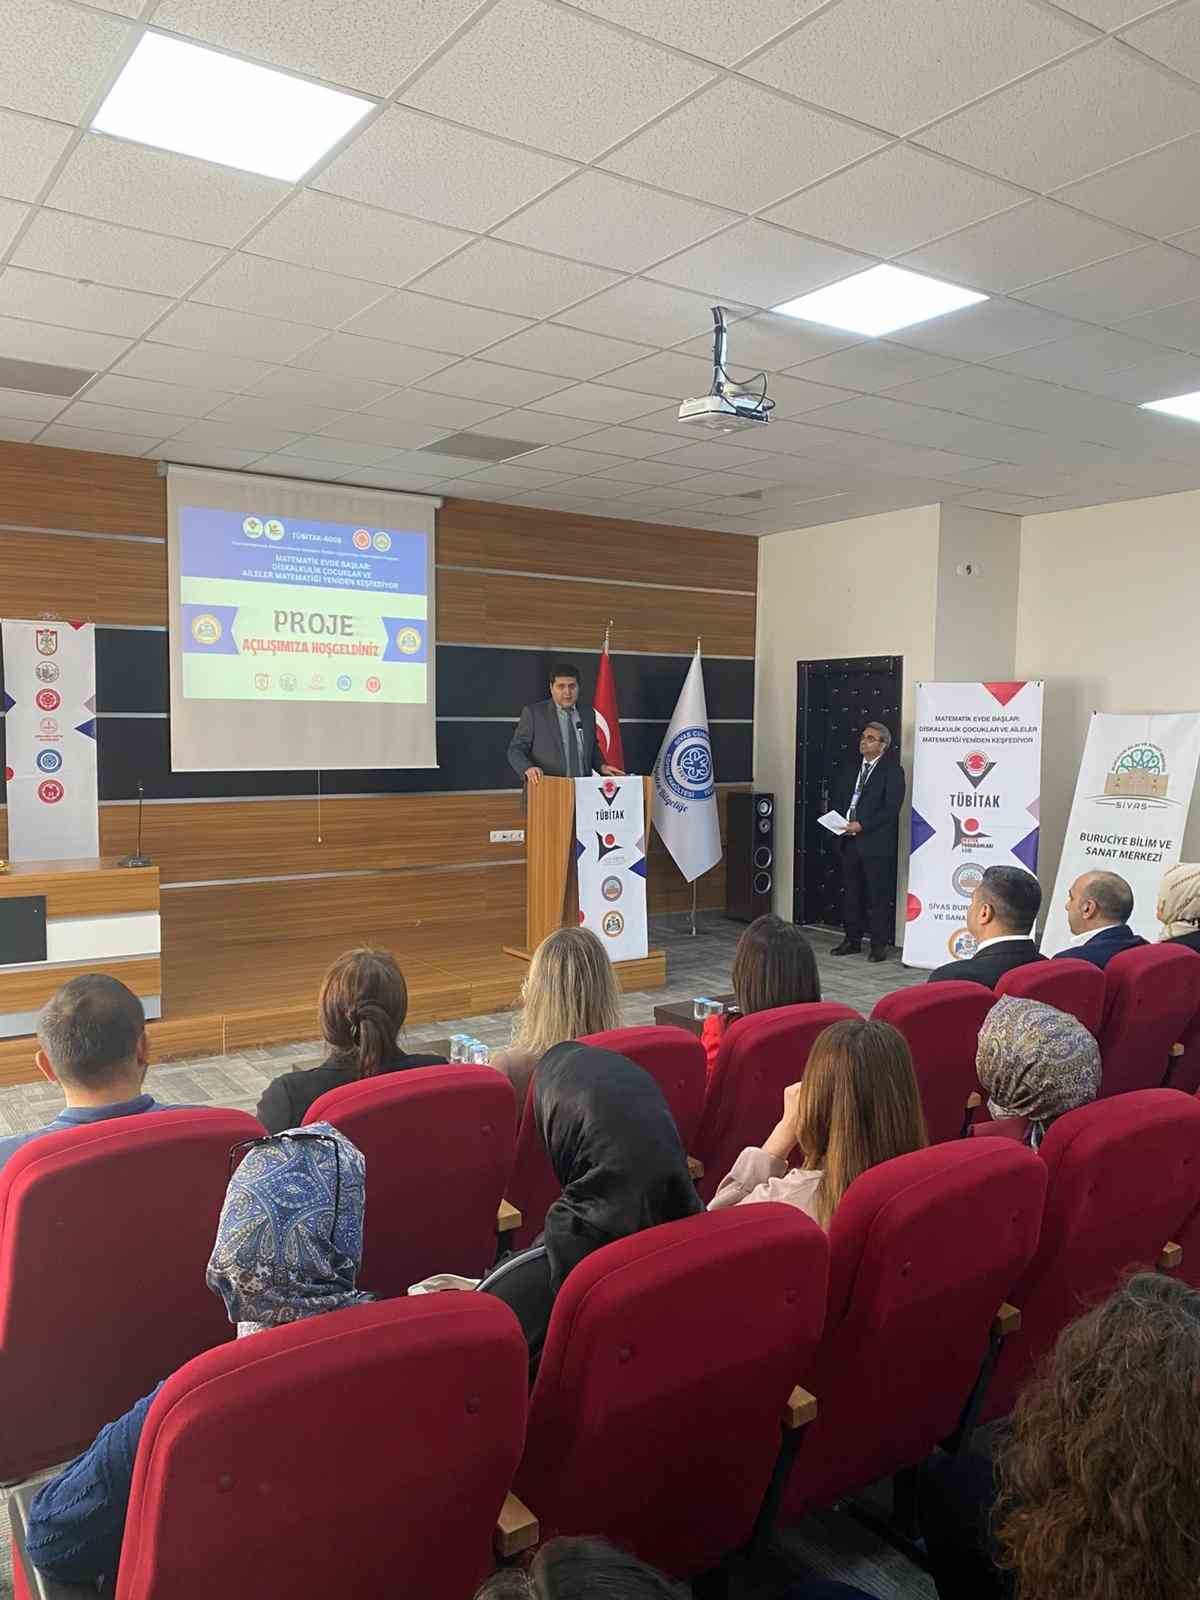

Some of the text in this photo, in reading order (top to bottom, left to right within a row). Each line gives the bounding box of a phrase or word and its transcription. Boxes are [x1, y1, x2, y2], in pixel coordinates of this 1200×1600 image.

[273, 609, 353, 636] PROJE
[242, 639, 379, 658] AÇILIŞIMIZA HOŞGELDİNİZ
[950, 791, 1000, 808] TÜBİTAK
[596, 808, 624, 821] TÜBİTAK
[1080, 831, 1173, 849] BURUCİYE BİLİM VE
[1085, 846, 1163, 863] SANAT MERKEZİ
[934, 913, 967, 921] VE SANA
